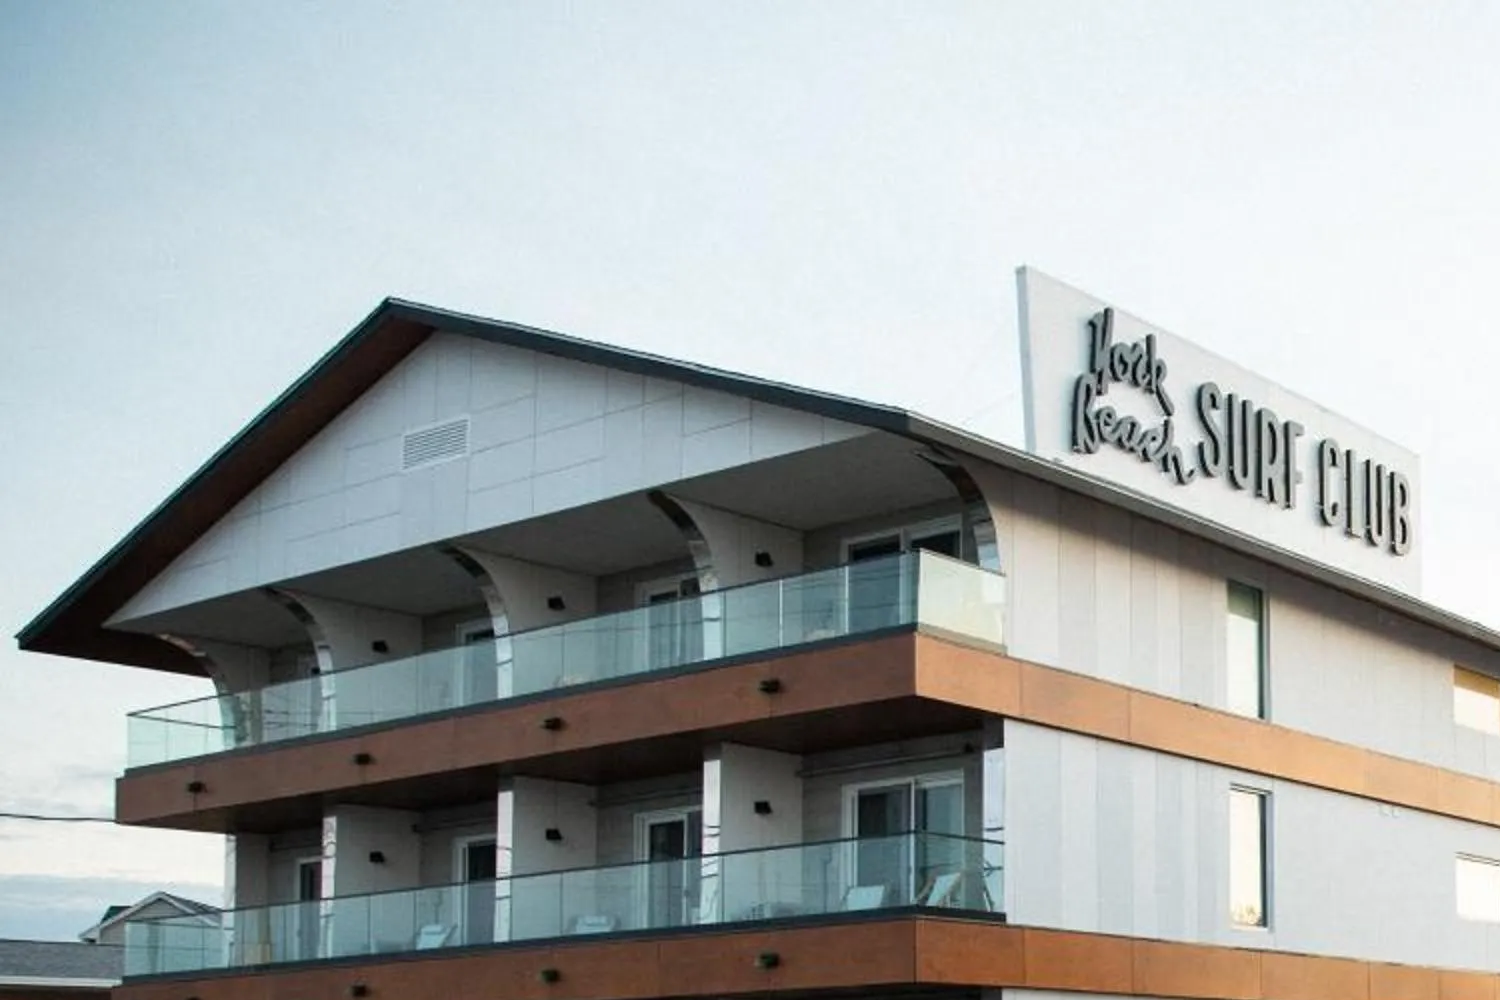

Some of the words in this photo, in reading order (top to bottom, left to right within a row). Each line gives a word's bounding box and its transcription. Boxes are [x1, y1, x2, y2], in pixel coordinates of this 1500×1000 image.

[1088, 306, 1175, 417] York
[1071, 371, 1196, 486] Beach
[1196, 381, 1304, 509] SURF
[1318, 437, 1411, 556] CLUB
